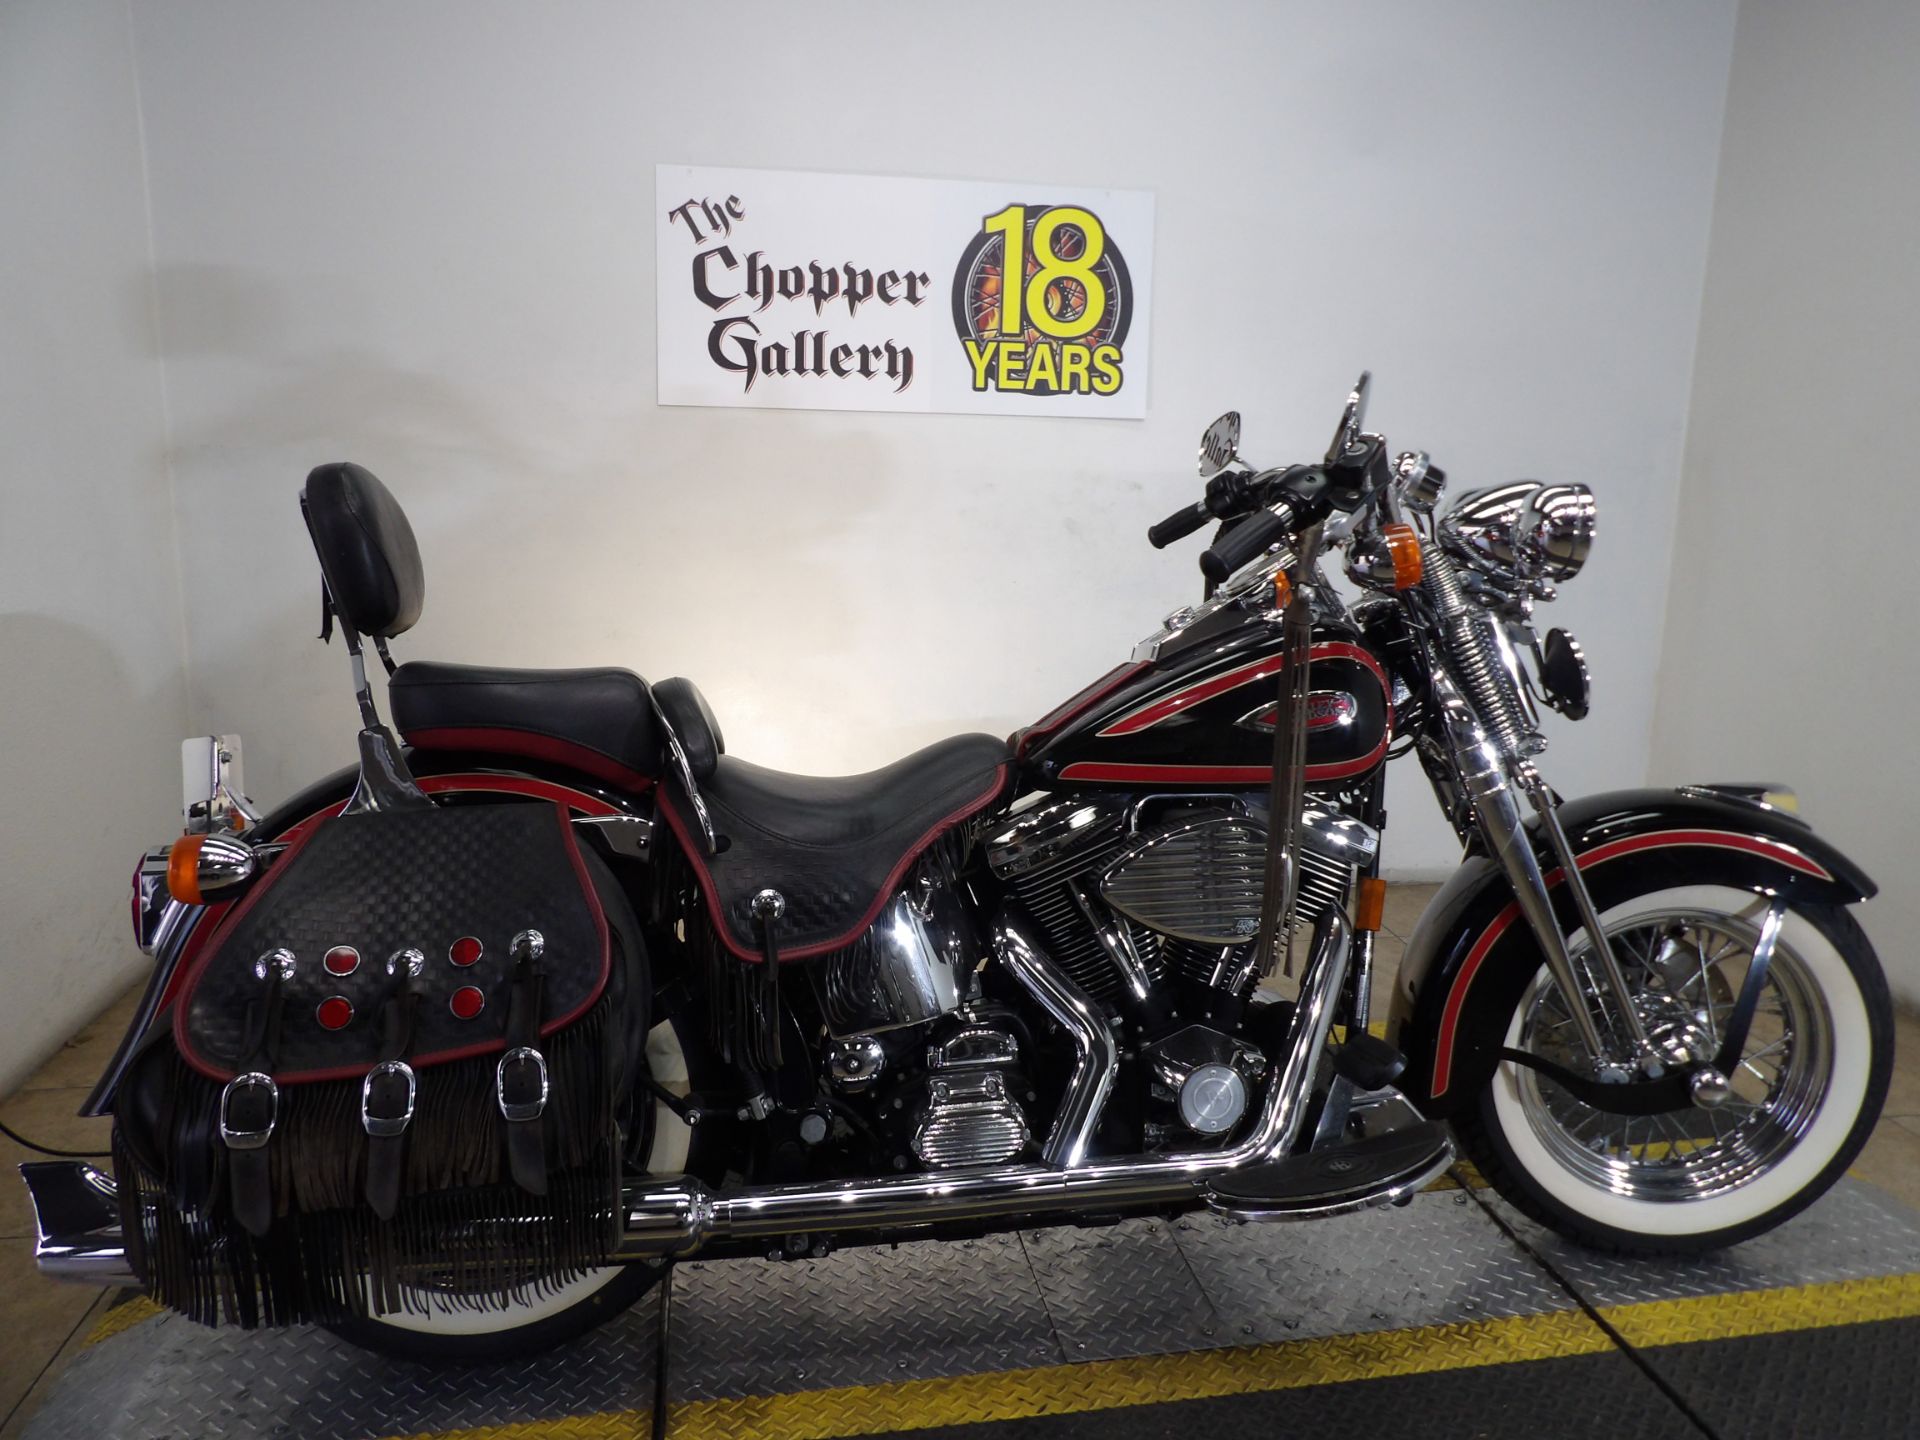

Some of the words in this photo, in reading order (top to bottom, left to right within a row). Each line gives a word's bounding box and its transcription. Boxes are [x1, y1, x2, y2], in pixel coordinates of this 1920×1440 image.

[669, 194, 745, 245] The
[692, 244, 931, 318] Chopper
[985, 204, 1107, 338] 18
[707, 315, 915, 394] Gallery
[966, 339, 1122, 393] YEARS
